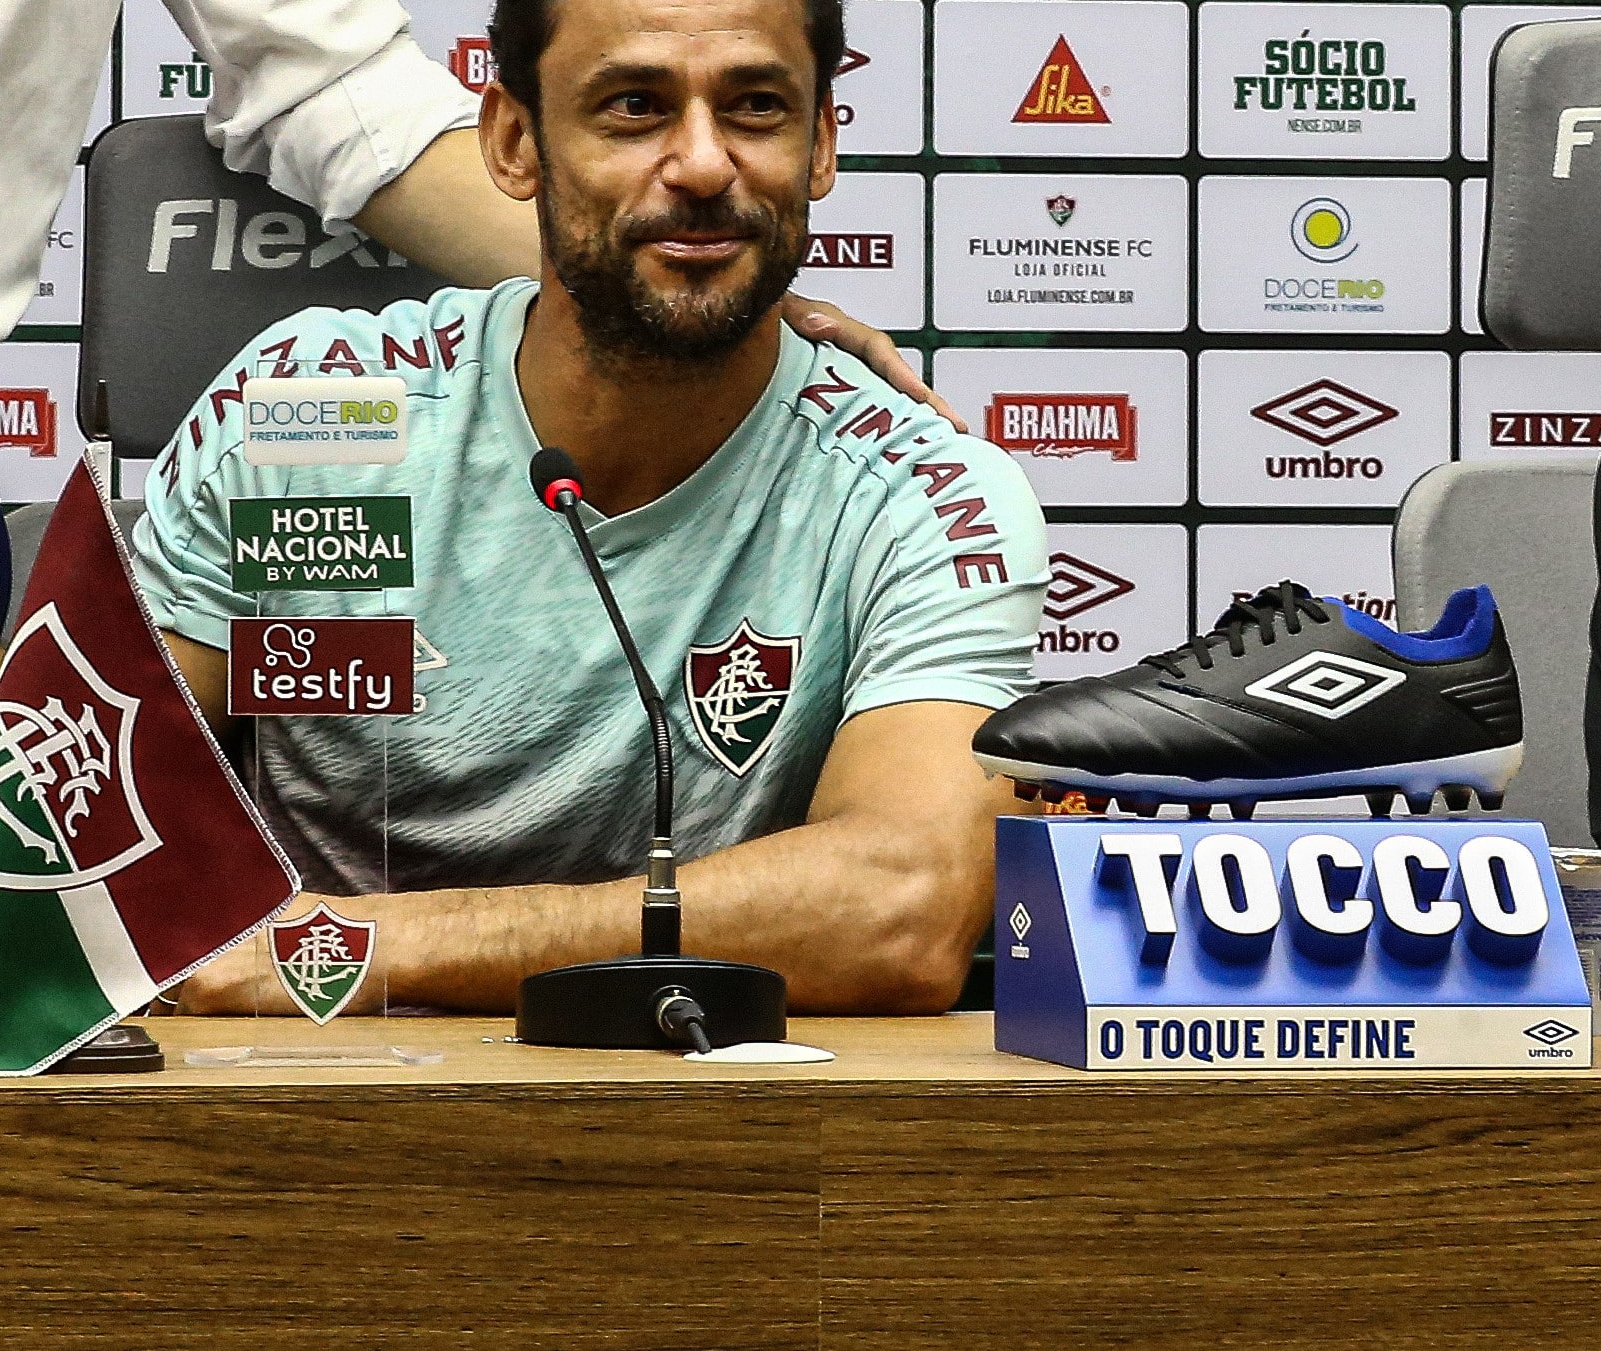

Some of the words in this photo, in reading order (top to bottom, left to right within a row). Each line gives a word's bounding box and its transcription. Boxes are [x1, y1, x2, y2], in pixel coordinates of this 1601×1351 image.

[1265, 29, 1386, 77] SÓCIO
[1234, 77, 1416, 112] FUTEBOL
[969, 236, 1121, 258] FLUMINENSE
[1127, 240, 1152, 259] FC
[249, 430, 329, 442] FRETAMENTO
[333, 430, 341, 441] E
[344, 430, 398, 441] TURISMO
[1004, 404, 1121, 440] BRAHMA
[272, 506, 370, 533] HOTEL
[236, 534, 407, 563] NACIONAL
[266, 567, 296, 581] BY
[303, 563, 379, 580] WAM
[253, 659, 392, 710] testfy
[1099, 834, 1550, 936] TOCCO
[1100, 1019, 1124, 1059] O
[1136, 1019, 1265, 1063] TOQUE
[1276, 1019, 1415, 1059] DEFINE
[1528, 1047, 1574, 1058] umbro
